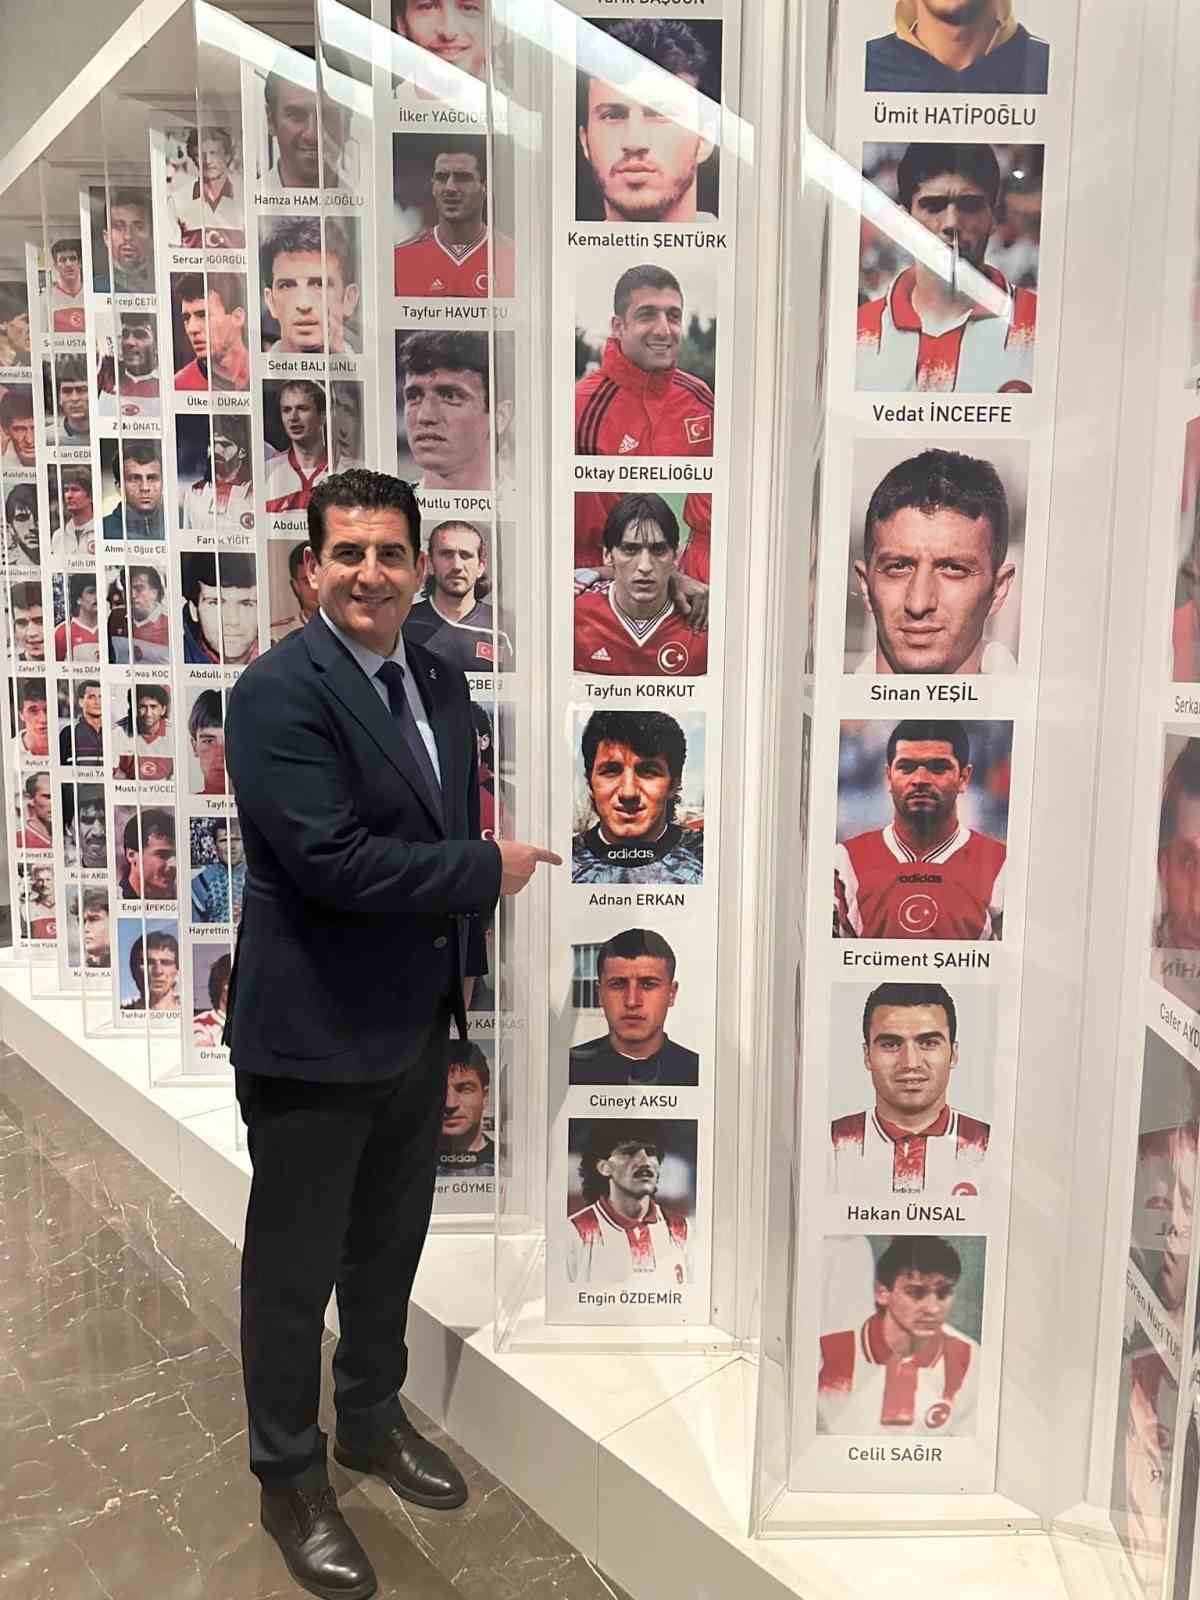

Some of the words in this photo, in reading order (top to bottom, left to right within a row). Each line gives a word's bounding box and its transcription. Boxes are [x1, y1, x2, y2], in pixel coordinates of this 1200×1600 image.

[399, 107, 429, 122] İlker
[873, 102, 919, 123] Ümit
[924, 104, 1037, 125] HATİPOĞLU
[254, 194, 291, 205] Hamza
[568, 232, 649, 247] Kemalettin
[653, 231, 727, 248] ŞENTÜRK
[106, 297, 132, 307] Rcep
[401, 306, 442, 320] Tayfur
[268, 360, 298, 371] Sedat
[872, 404, 925, 421] Vedat
[929, 400, 1013, 422] İNCEEFE
[574, 465, 616, 482] Oktay
[618, 464, 713, 481] DERELİOĞLU
[416, 498, 450, 509] Mutlu
[272, 520, 310, 530] Abdull
[585, 684, 632, 699] Tayfun
[636, 684, 695, 697] KORKUT
[871, 685, 920, 701] Sinan
[926, 685, 979, 704] YEŞİL
[607, 848, 655, 860] adidas
[589, 894, 632, 906] Adnan
[636, 894, 685, 906] ERKAN
[189, 926, 230, 937] Hayrettin
[842, 951, 929, 968] Ercüment
[933, 950, 990, 969] ŞAHİN
[1159, 1003, 1182, 1032] Cafer
[589, 1094, 636, 1110] Cüneyt
[640, 1095, 678, 1108] AKSU
[847, 1206, 901, 1221] Hakan
[905, 1204, 966, 1221] ÜNSAL
[578, 1291, 616, 1306] Engin
[619, 1288, 683, 1304] ÖZDEMİR
[848, 1446, 887, 1461] Celil
[890, 1444, 943, 1462] SAĞIR
